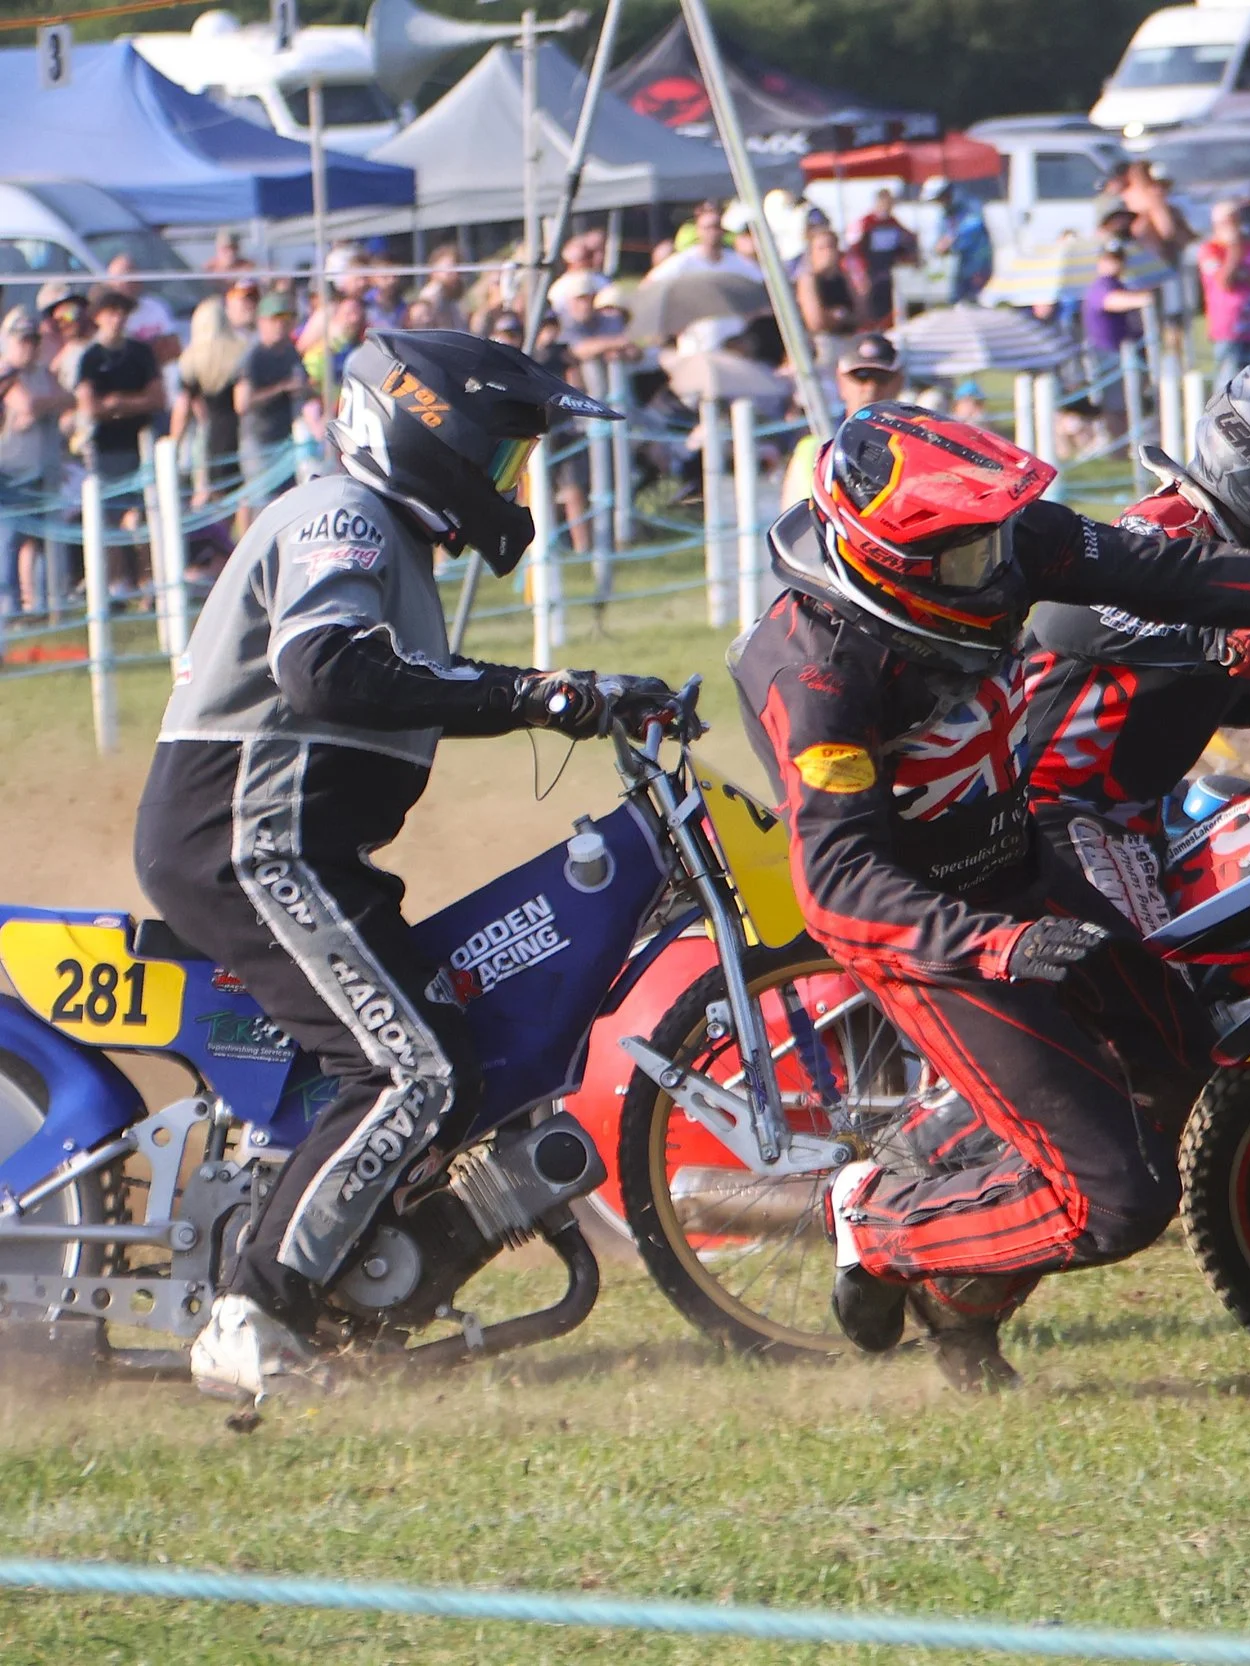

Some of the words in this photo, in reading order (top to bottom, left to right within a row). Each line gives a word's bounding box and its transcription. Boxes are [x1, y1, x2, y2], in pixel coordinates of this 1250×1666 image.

[300, 508, 383, 544] HAGON
[929, 848, 996, 878] Specialist
[450, 894, 551, 970] ODDEN
[51, 959, 147, 1026] 281
[331, 961, 416, 1067] HAGON
[341, 1081, 424, 1201] HAGON
